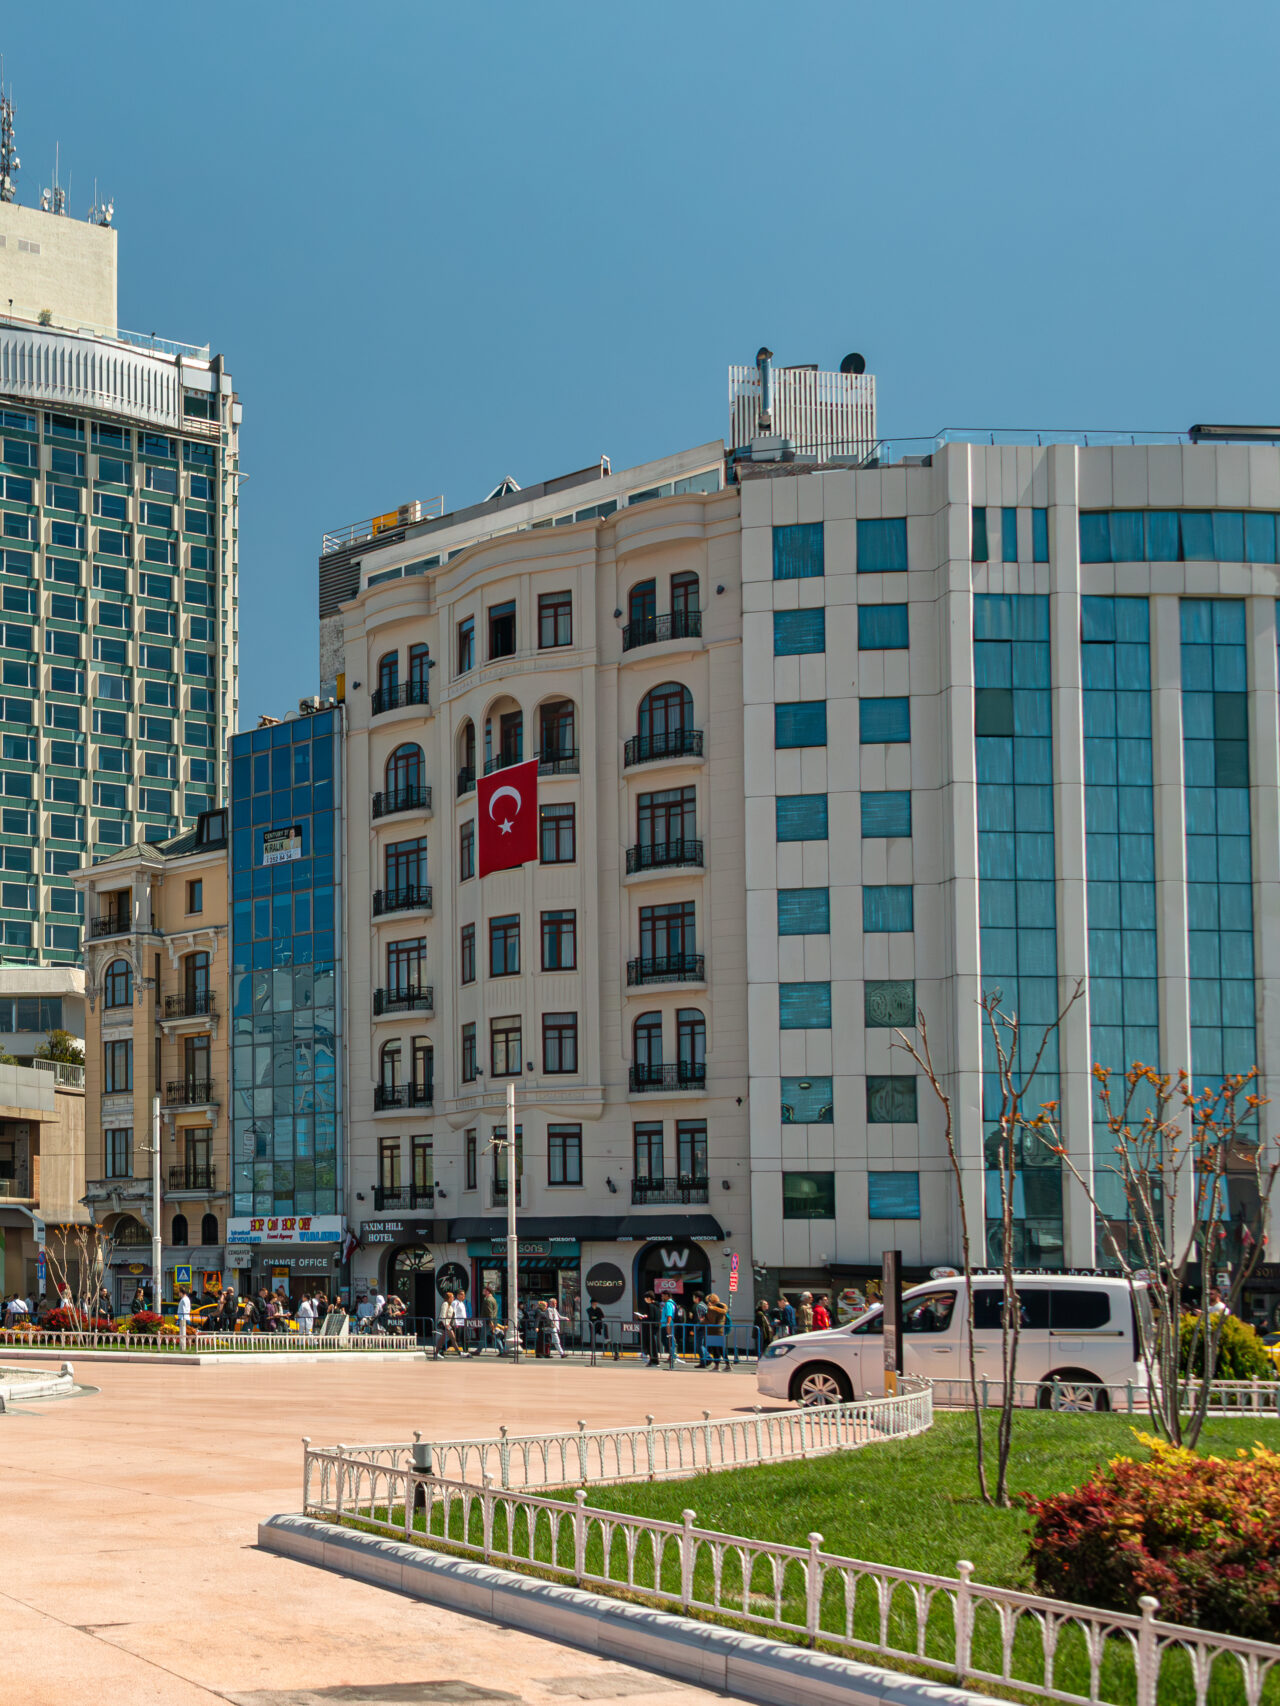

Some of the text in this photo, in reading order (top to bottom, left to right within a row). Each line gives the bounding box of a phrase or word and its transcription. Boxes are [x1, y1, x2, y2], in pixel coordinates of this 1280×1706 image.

[250, 1218, 264, 1231] HOP
[267, 1218, 279, 1231] ON
[281, 1217, 296, 1231] HOP
[385, 1222, 404, 1231] HILL
[368, 1233, 394, 1242] HOTEL
[660, 1248, 689, 1267] W
[263, 1258, 328, 1267] CHANGE OFFICE
[623, 1323, 640, 1332] POLIS
